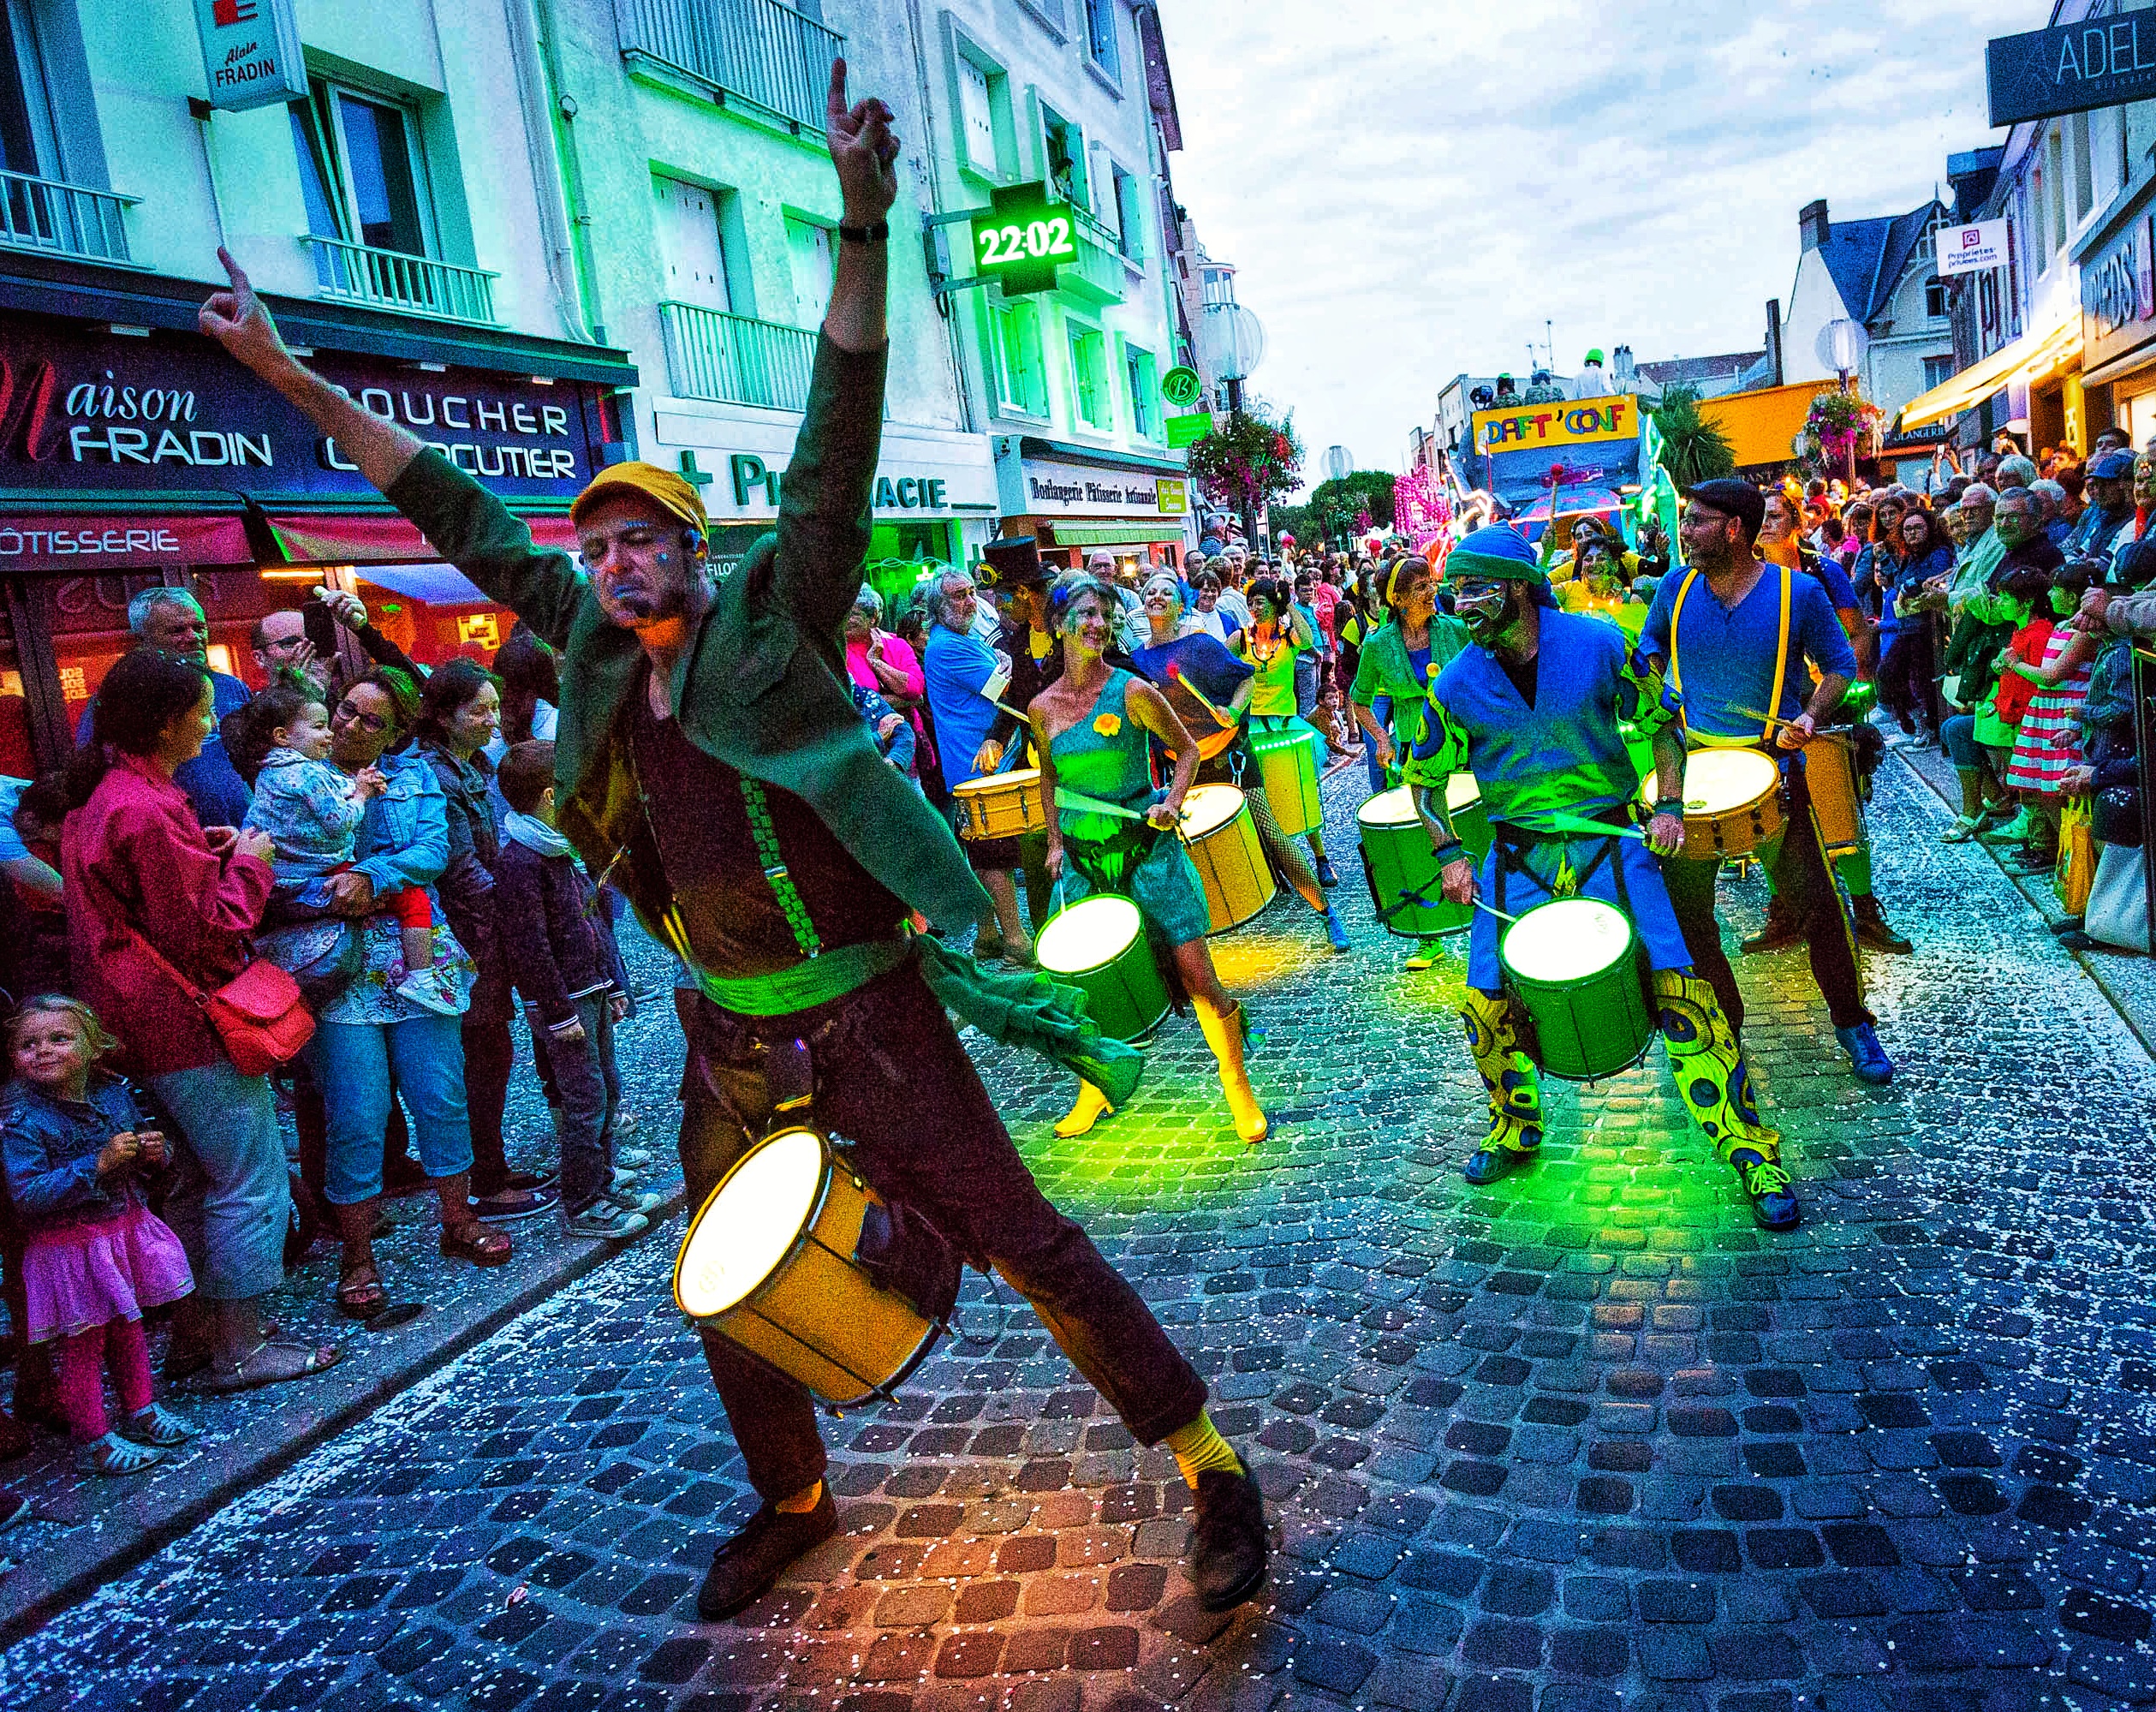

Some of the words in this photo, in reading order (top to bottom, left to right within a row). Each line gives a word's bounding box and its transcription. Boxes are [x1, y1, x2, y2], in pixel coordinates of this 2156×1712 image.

[215, 58, 276, 87] FRADIN
[224, 41, 258, 68] Alain
[979, 217, 1073, 265] 22:02
[328, 385, 569, 436] OUCHER
[69, 426, 273, 467] FRADIN
